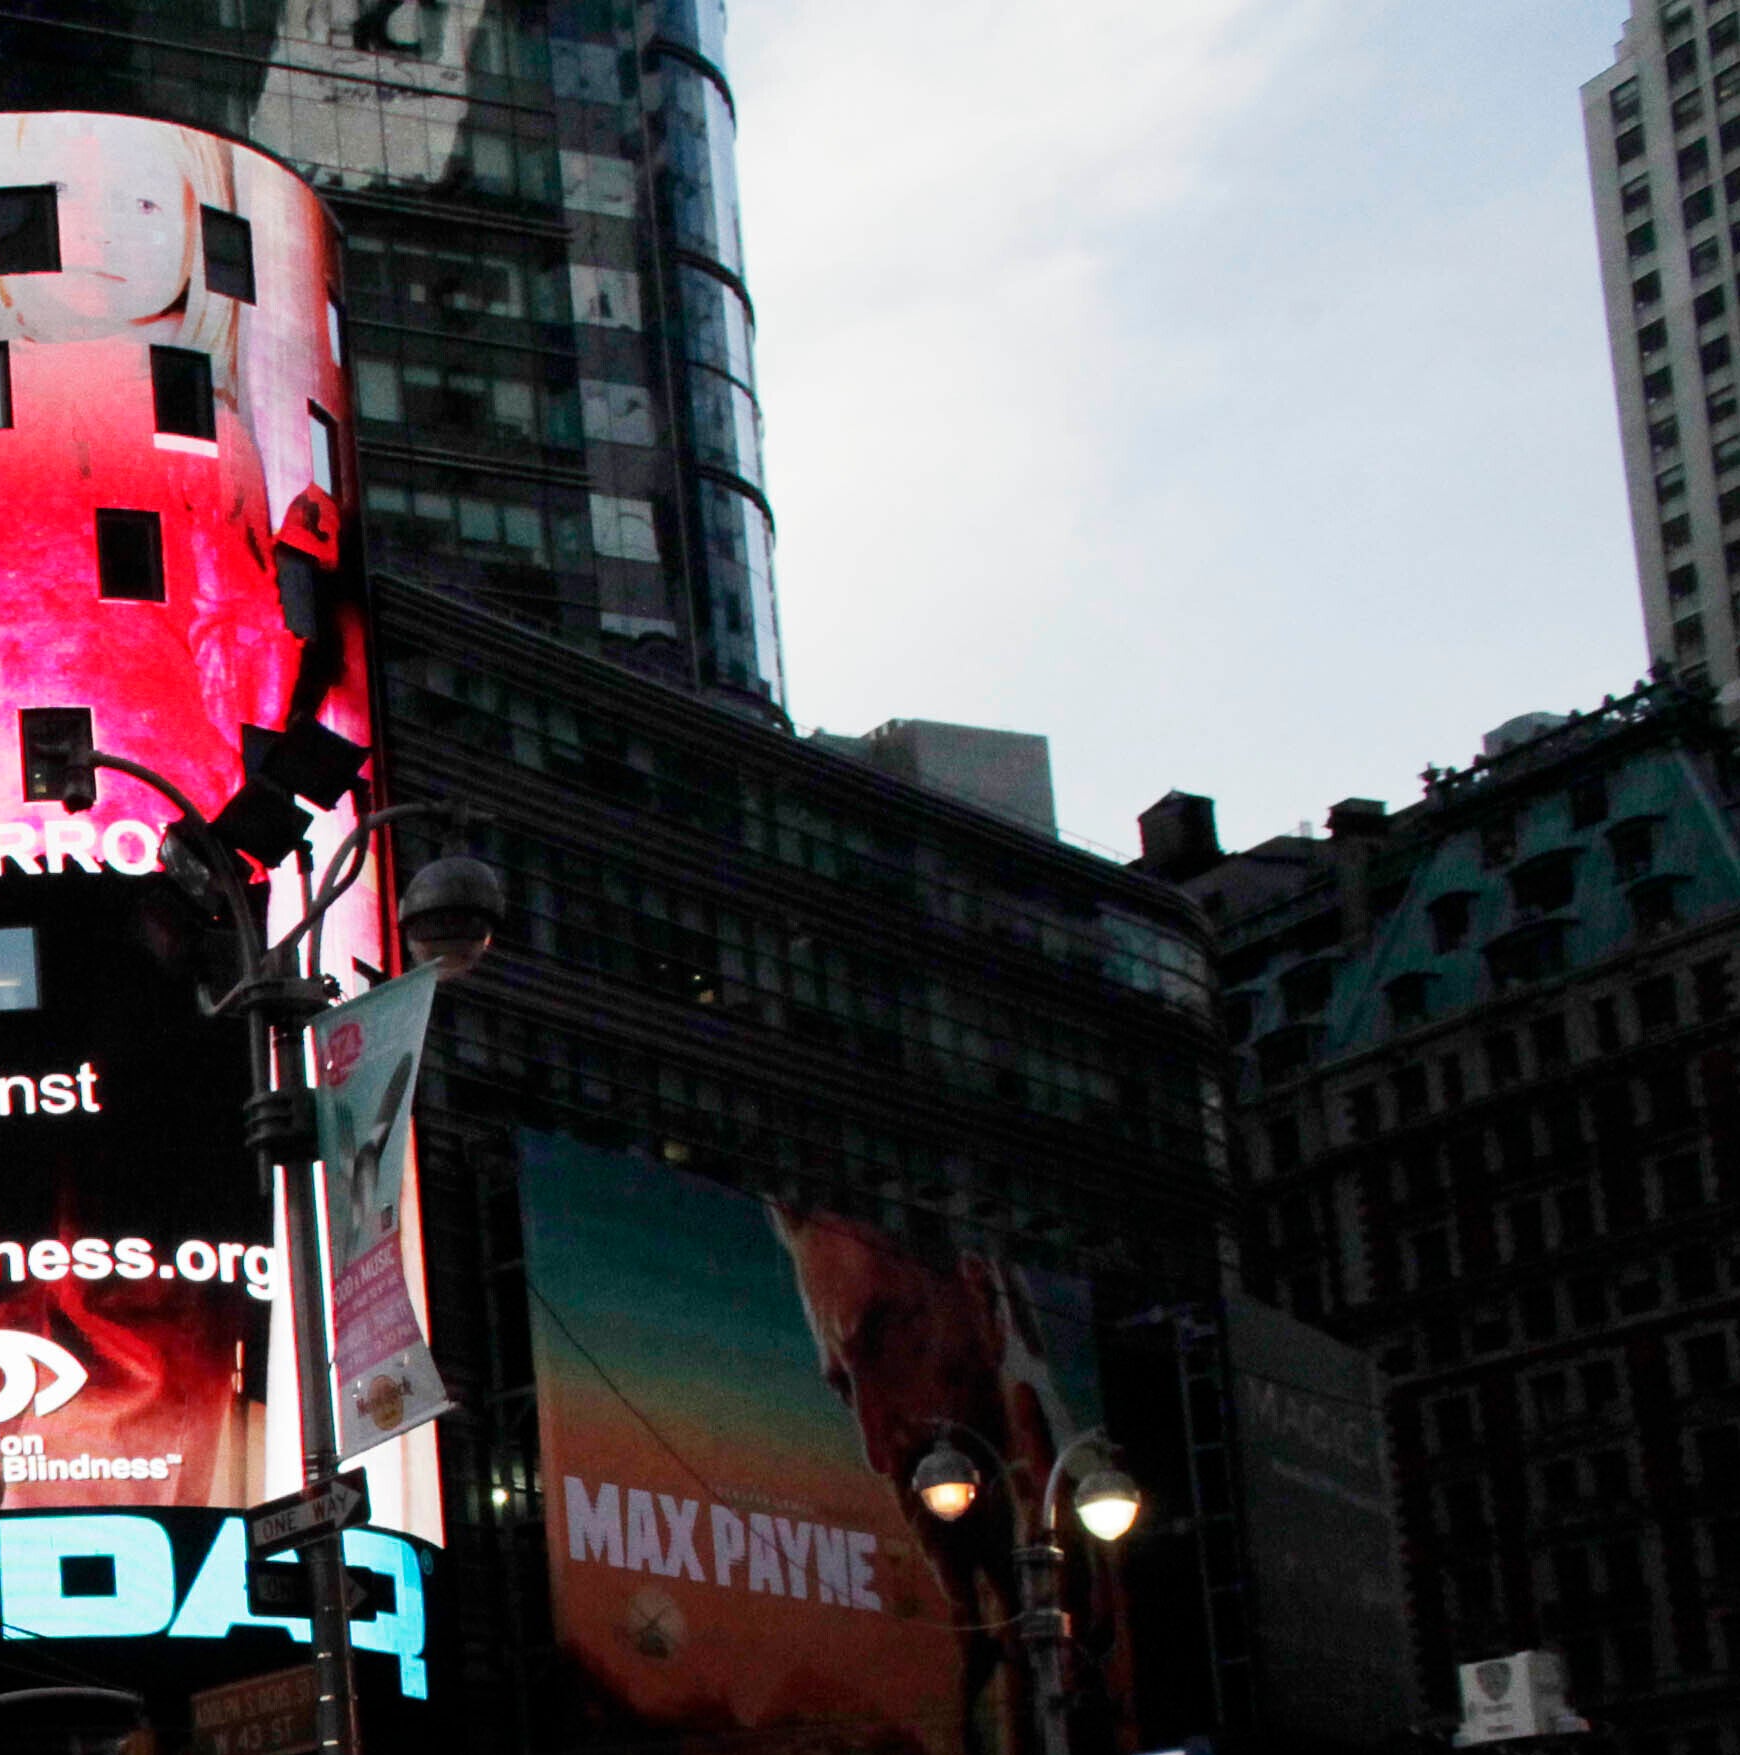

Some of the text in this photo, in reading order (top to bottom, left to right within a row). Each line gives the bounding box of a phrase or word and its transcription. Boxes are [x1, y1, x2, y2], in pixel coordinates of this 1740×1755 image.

[261, 1491, 351, 1541] ONE WAY
[563, 1475, 707, 1583] MAX
[709, 1504, 883, 1612] PAYNE
